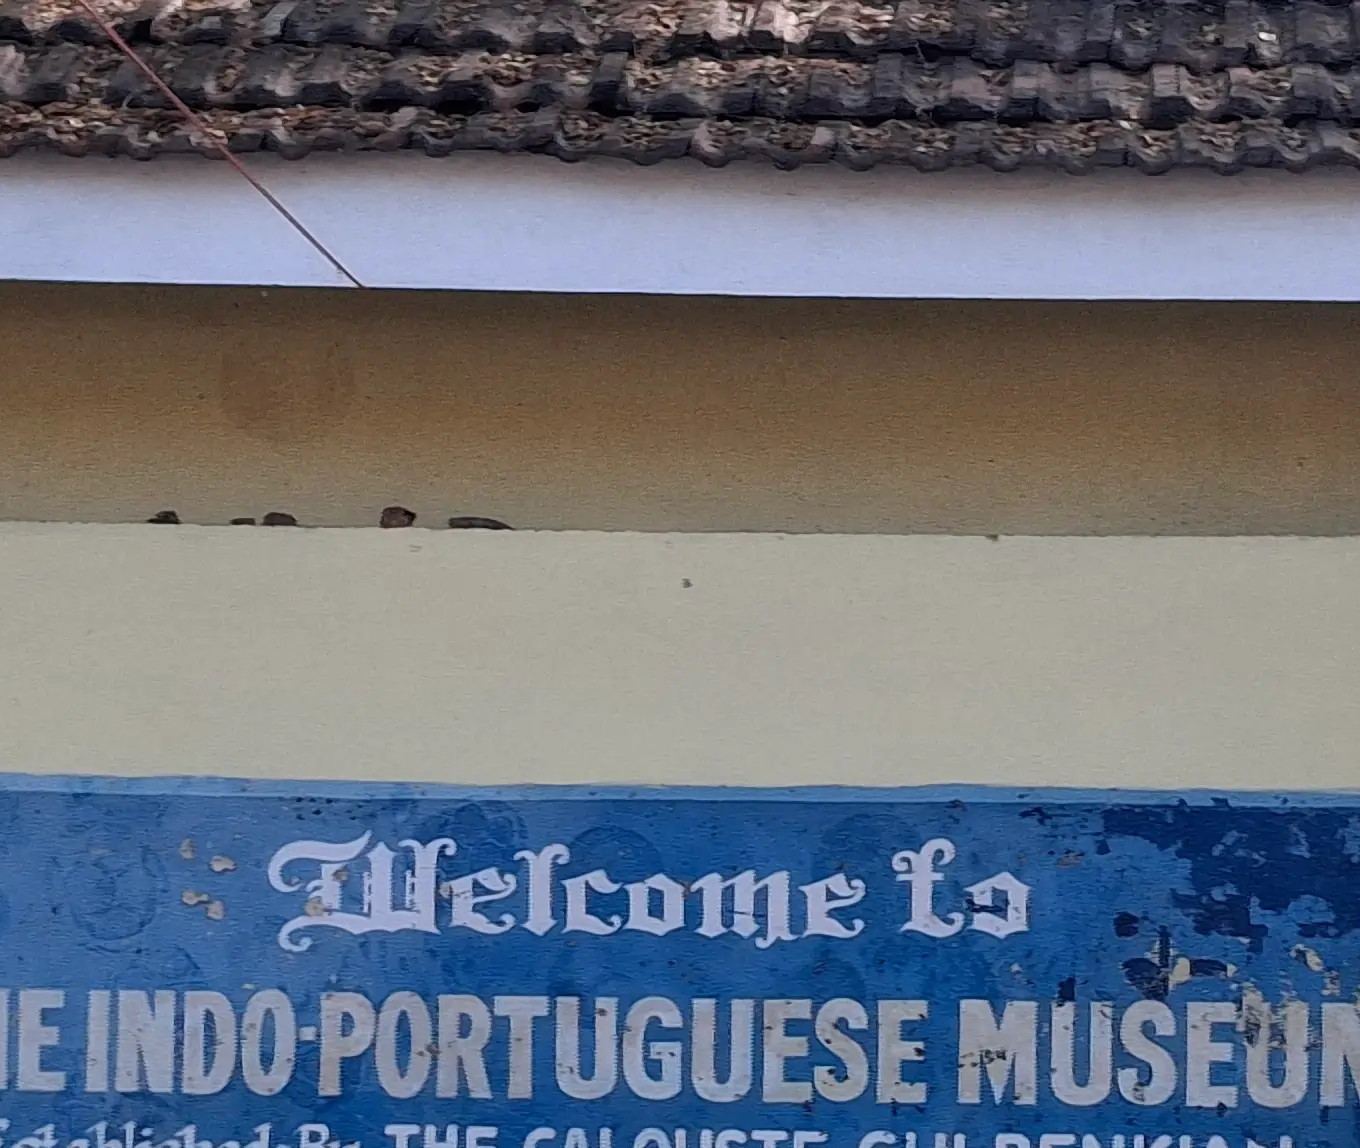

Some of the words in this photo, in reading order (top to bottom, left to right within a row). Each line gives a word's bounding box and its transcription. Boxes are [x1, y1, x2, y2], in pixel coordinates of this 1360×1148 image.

[267, 829, 866, 952] Welcome
[892, 838, 1031, 940] to
[86, 990, 928, 1105] INDO-PORTUGUESE
